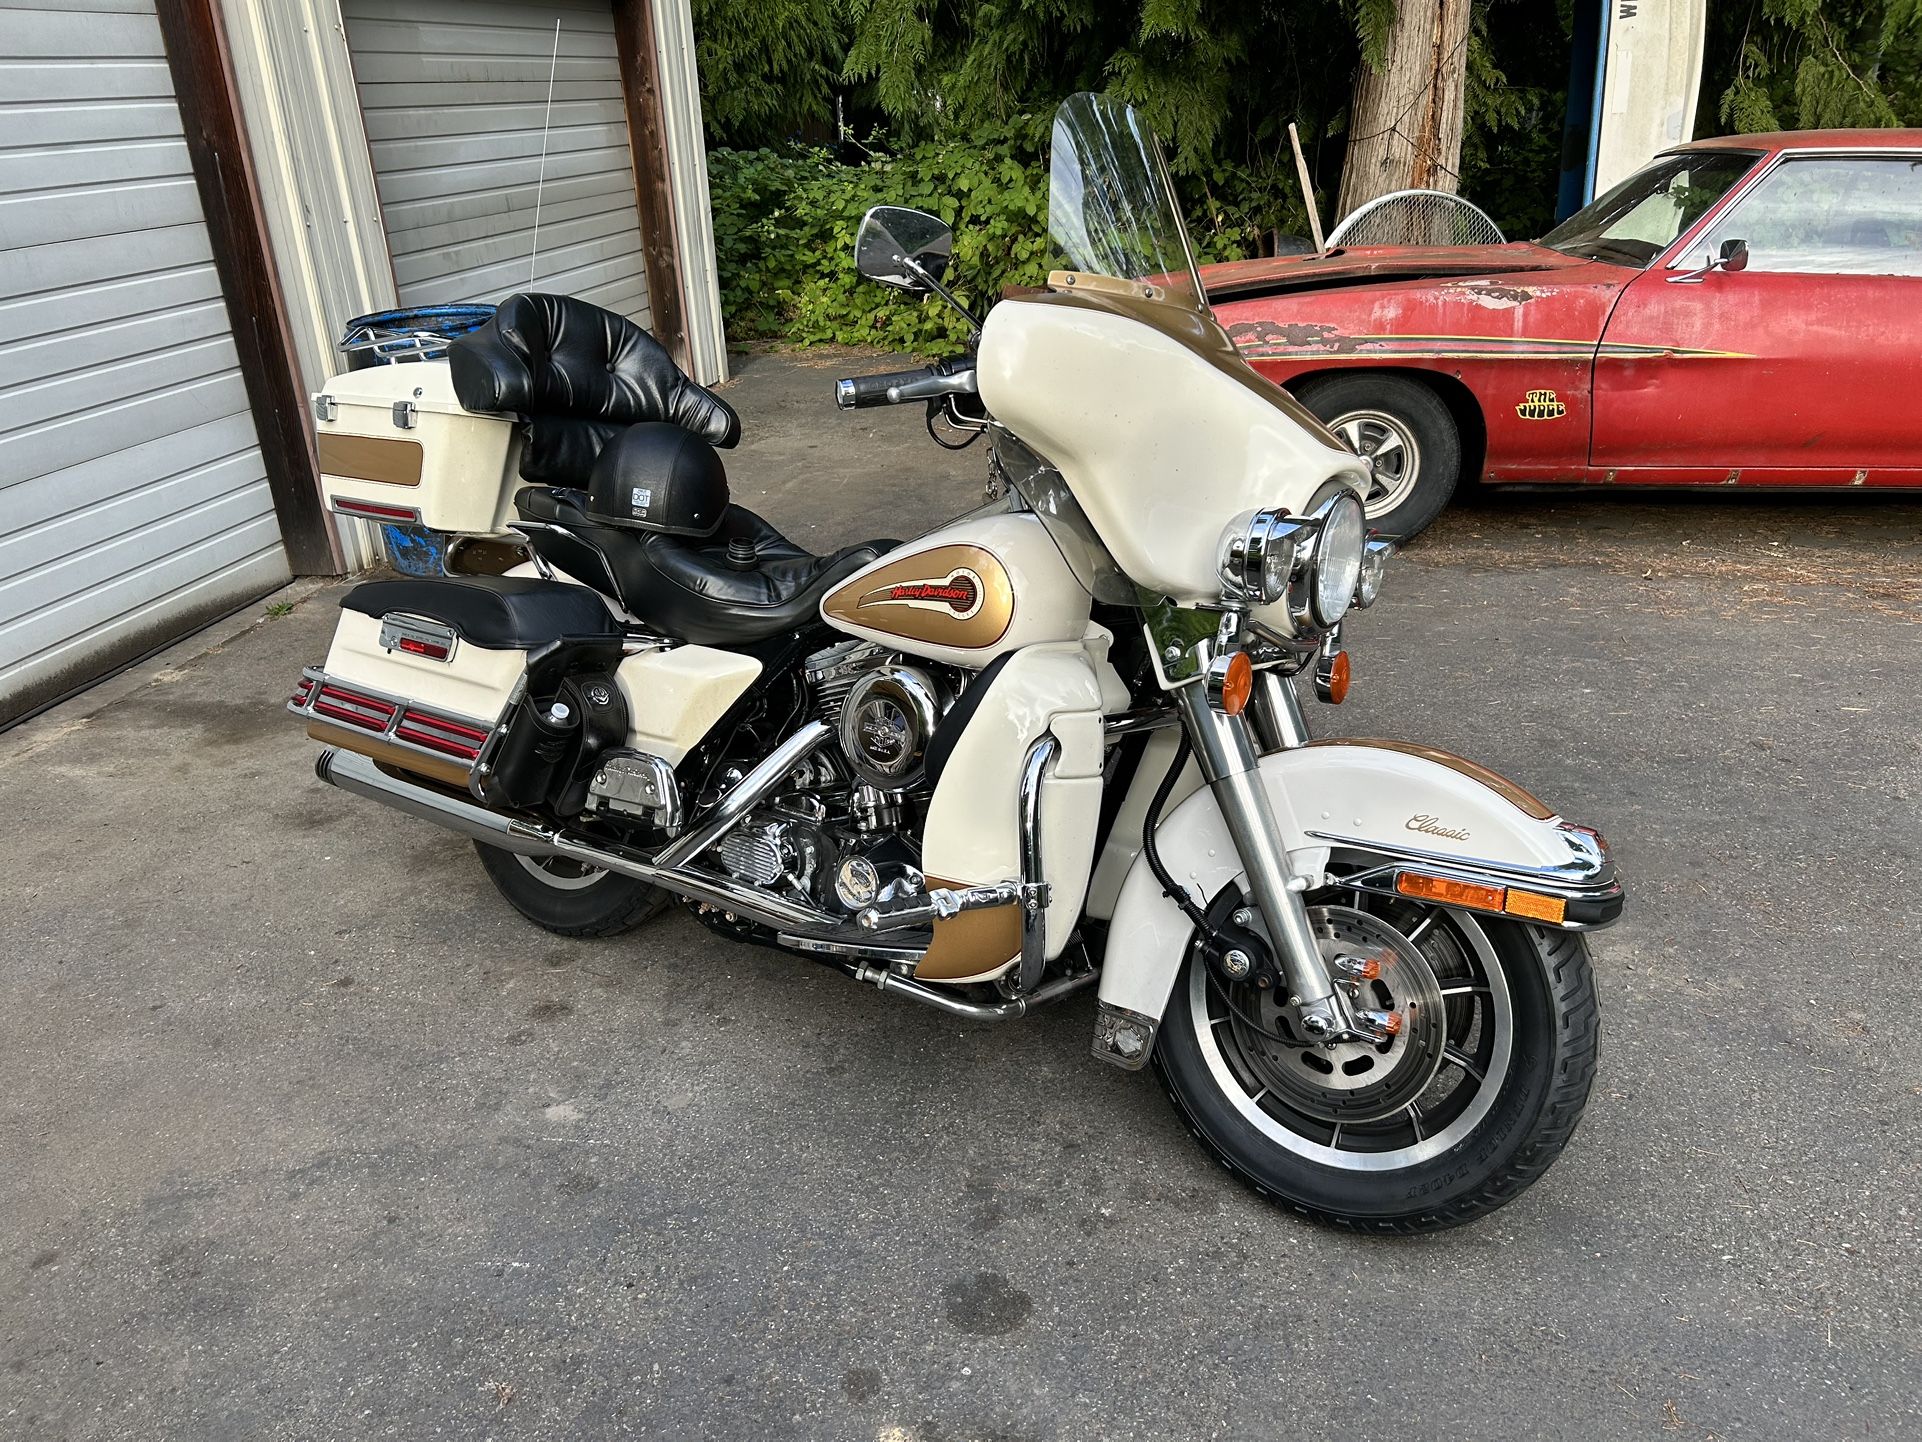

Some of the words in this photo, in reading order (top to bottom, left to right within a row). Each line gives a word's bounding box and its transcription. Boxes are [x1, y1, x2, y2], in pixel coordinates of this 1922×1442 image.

[1619, 0, 1638, 19] W
[1527, 391, 1556, 403] THE
[1518, 403, 1565, 418] JUDGE
[1405, 814, 1470, 841] Classic
